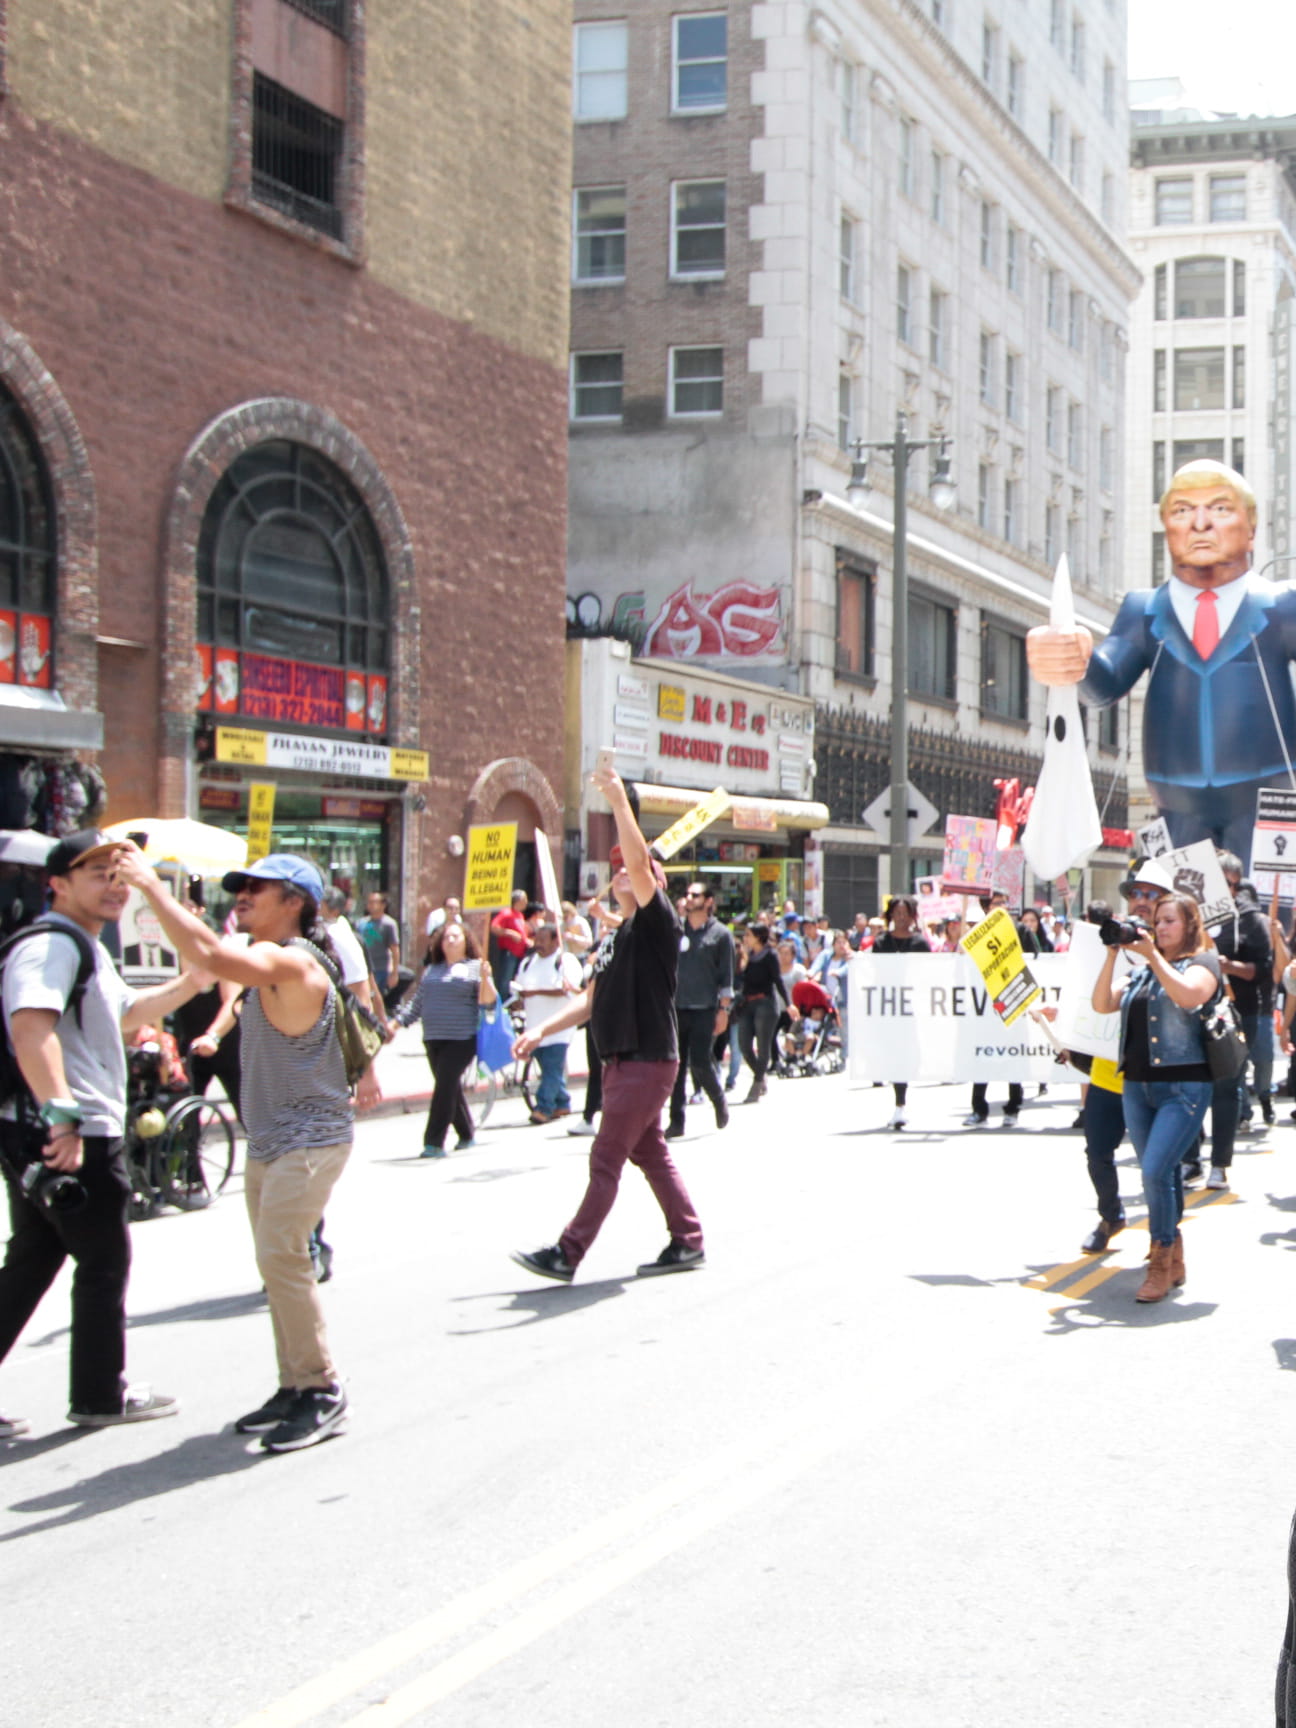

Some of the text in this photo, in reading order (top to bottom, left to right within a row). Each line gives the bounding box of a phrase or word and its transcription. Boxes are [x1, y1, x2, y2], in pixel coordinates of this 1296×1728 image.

[691, 694, 712, 725] M
[715, 702, 727, 723] &
[731, 700, 748, 732] E
[332, 744, 389, 761] JEWELRY
[659, 731, 724, 766] DISCOUNT
[727, 744, 769, 771] CENTER
[486, 830, 501, 842] NO
[472, 849, 511, 864] HUMAN
[472, 867, 508, 880] BEING IS
[861, 986, 914, 1016] THE
